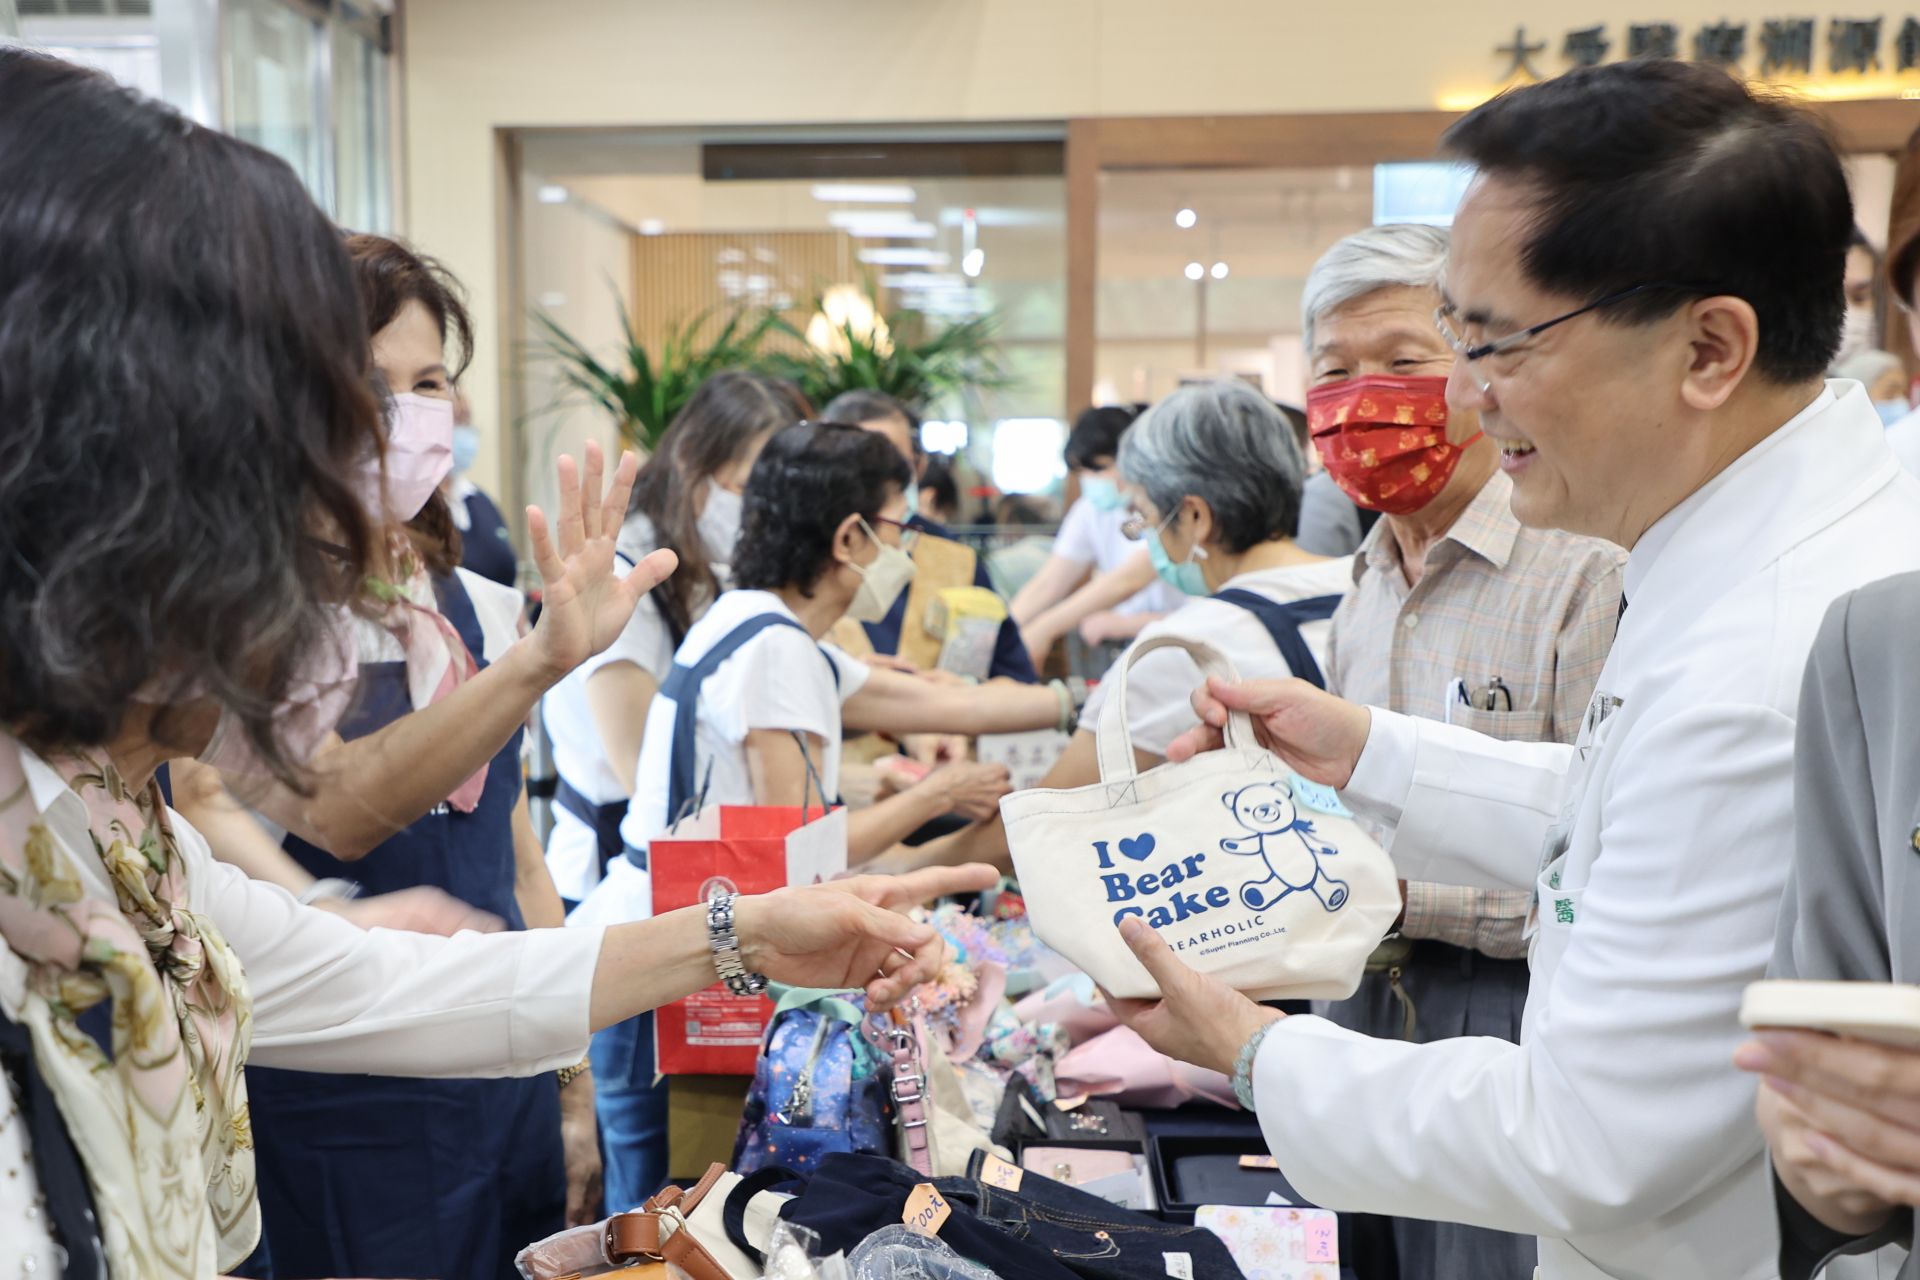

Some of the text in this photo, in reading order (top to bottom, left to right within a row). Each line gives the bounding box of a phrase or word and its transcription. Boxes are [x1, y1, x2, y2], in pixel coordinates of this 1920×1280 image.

[1092, 841, 1115, 868] I
[1100, 853, 1205, 902] Bear
[1228, 934, 1259, 948] Planning
[909, 1194, 944, 1228] 00元
